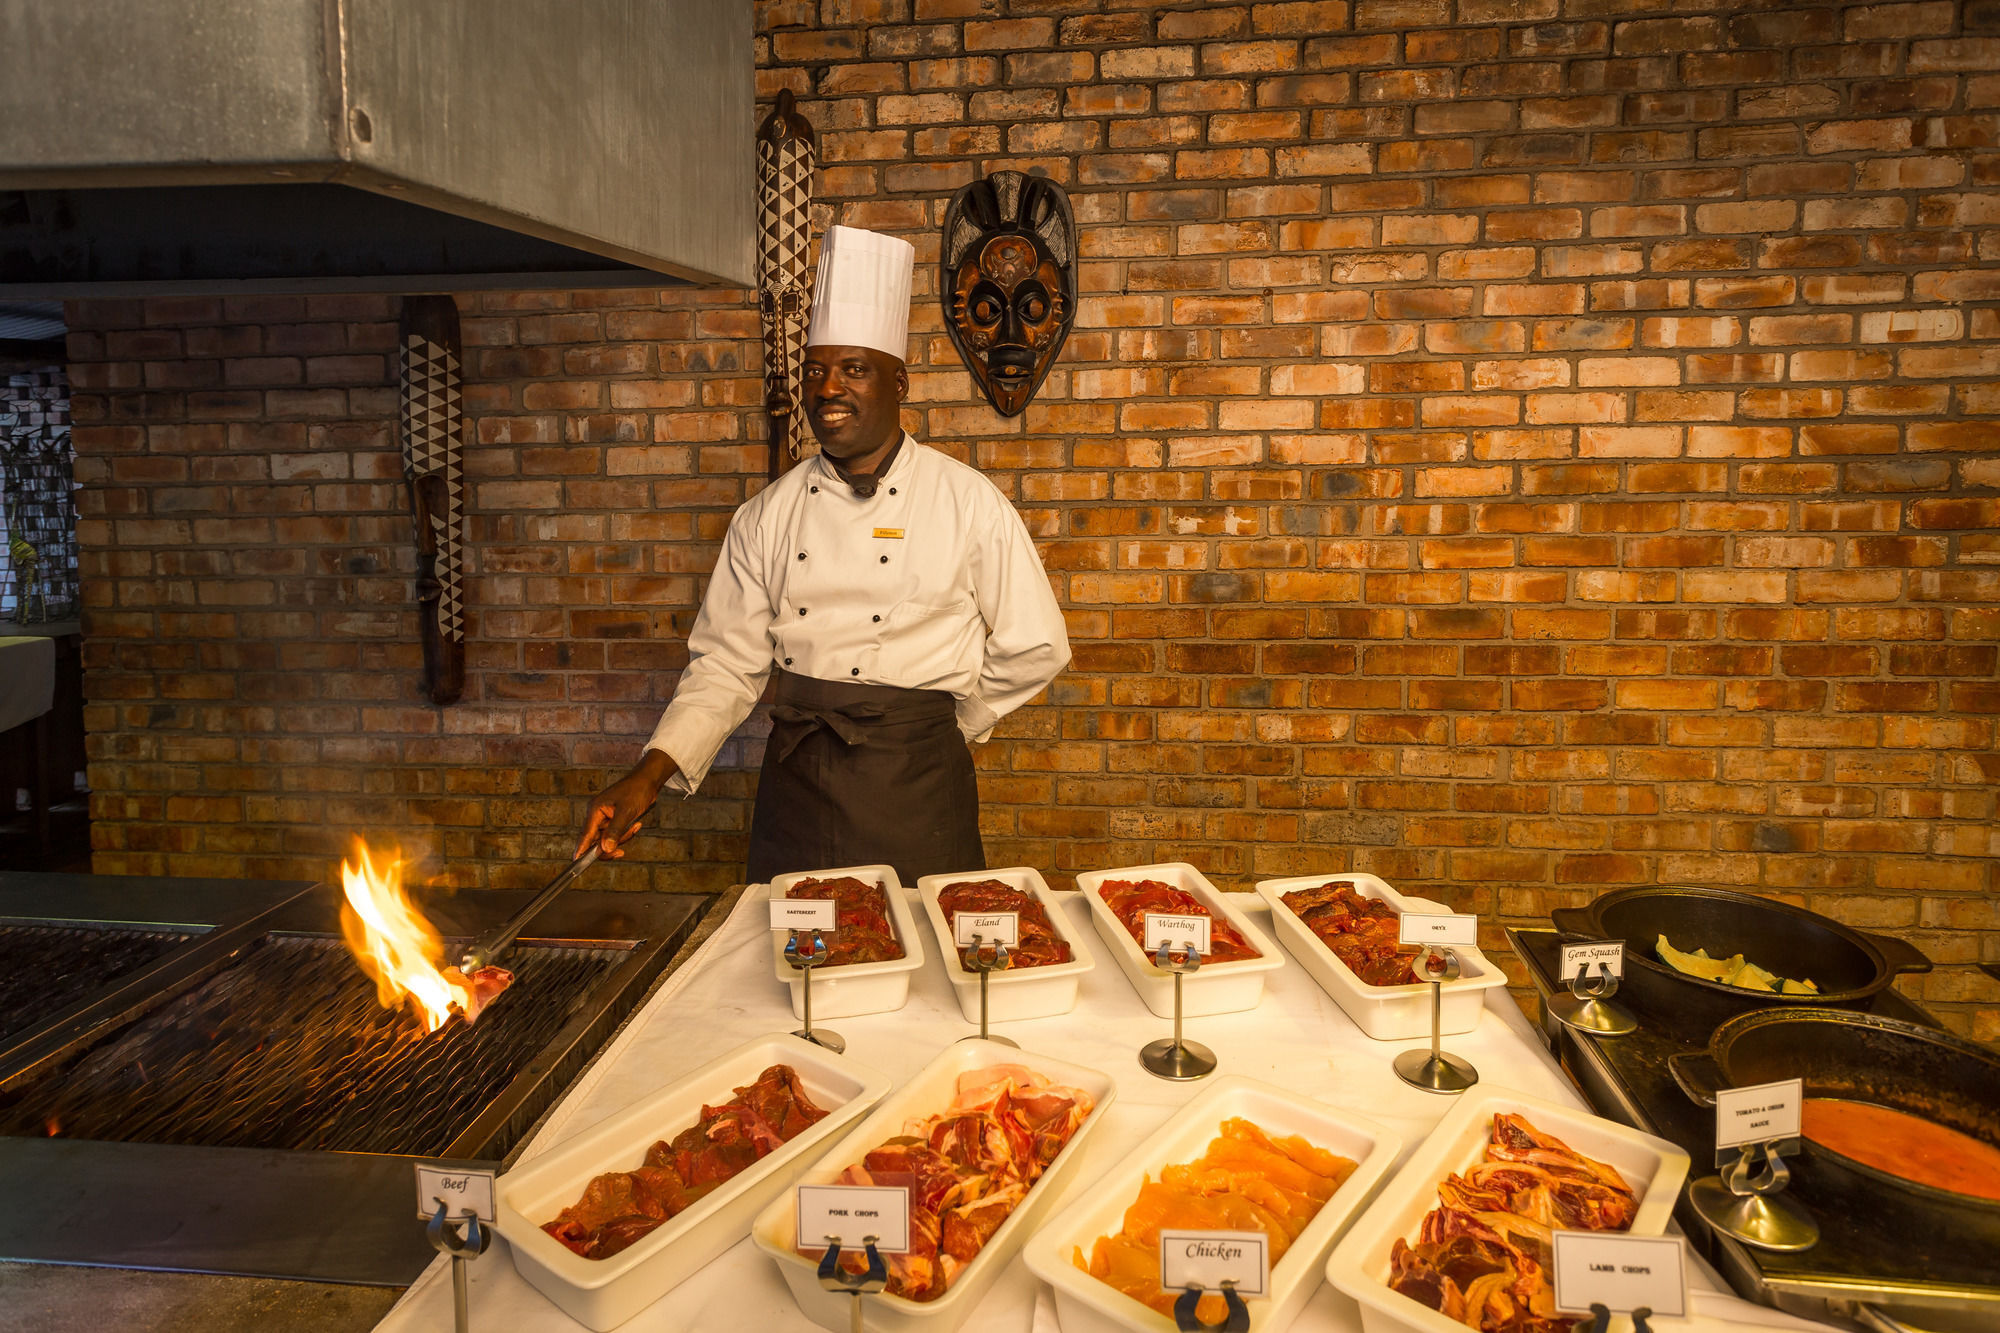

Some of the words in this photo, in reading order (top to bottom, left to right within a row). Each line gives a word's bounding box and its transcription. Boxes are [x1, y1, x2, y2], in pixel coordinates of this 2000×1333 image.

[974, 917, 1001, 927] Eland
[1157, 919, 1196, 932] Warthog
[1567, 949, 1587, 961] Gem
[1588, 946, 1621, 960] Squash
[441, 1176, 470, 1193] Beef
[829, 1209, 849, 1217] PORK
[854, 1210, 879, 1218] CHOPS
[1185, 1241, 1242, 1261] Chicken
[1589, 1263, 1616, 1273] LAMB
[1621, 1265, 1651, 1275] CHOPS
